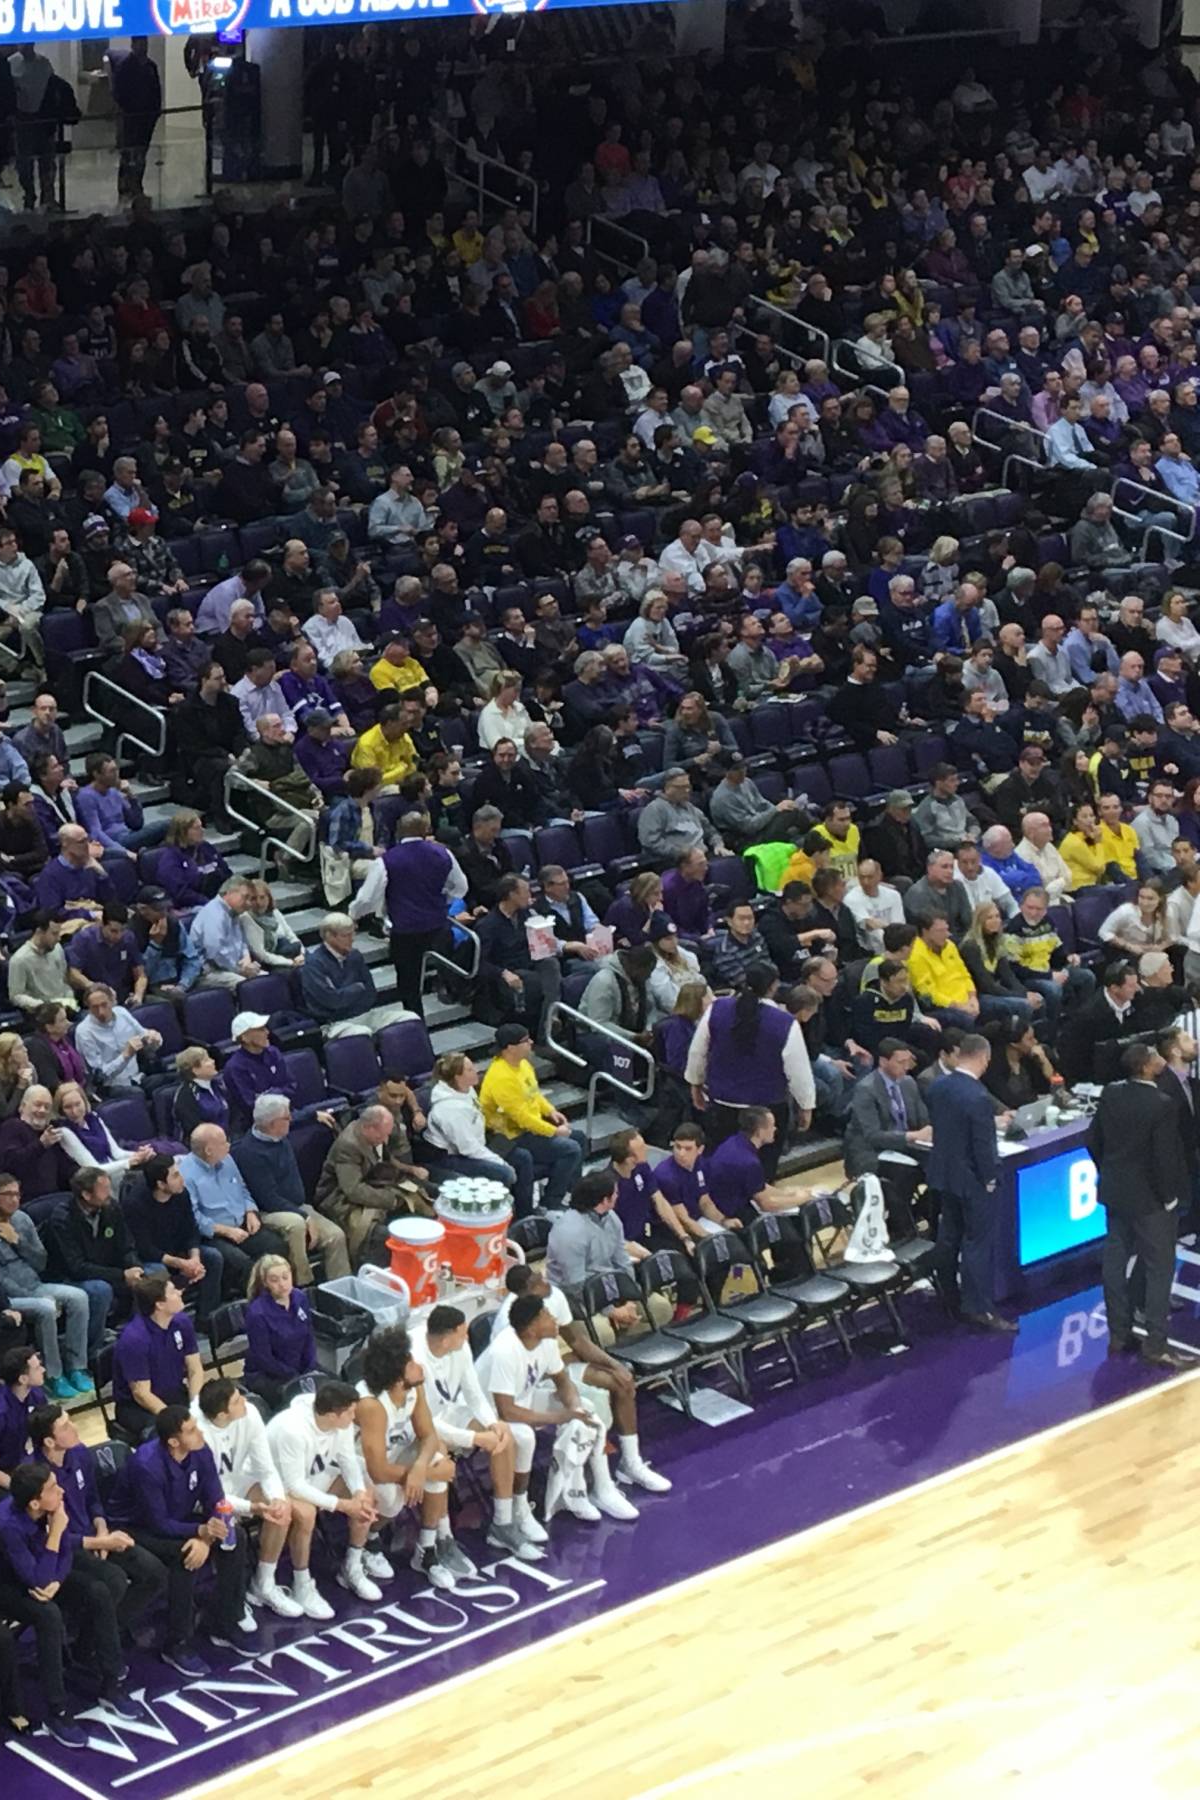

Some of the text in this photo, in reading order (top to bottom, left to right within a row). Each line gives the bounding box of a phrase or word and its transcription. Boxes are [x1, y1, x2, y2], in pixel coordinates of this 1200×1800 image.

[22, 0, 123, 32] ABOVE
[612, 1054, 632, 1069] 107
[1069, 1159, 1098, 1221] B
[488, 1234, 503, 1255] G
[423, 1253, 438, 1273] G
[34, 1557, 573, 1763] WINTRUST
